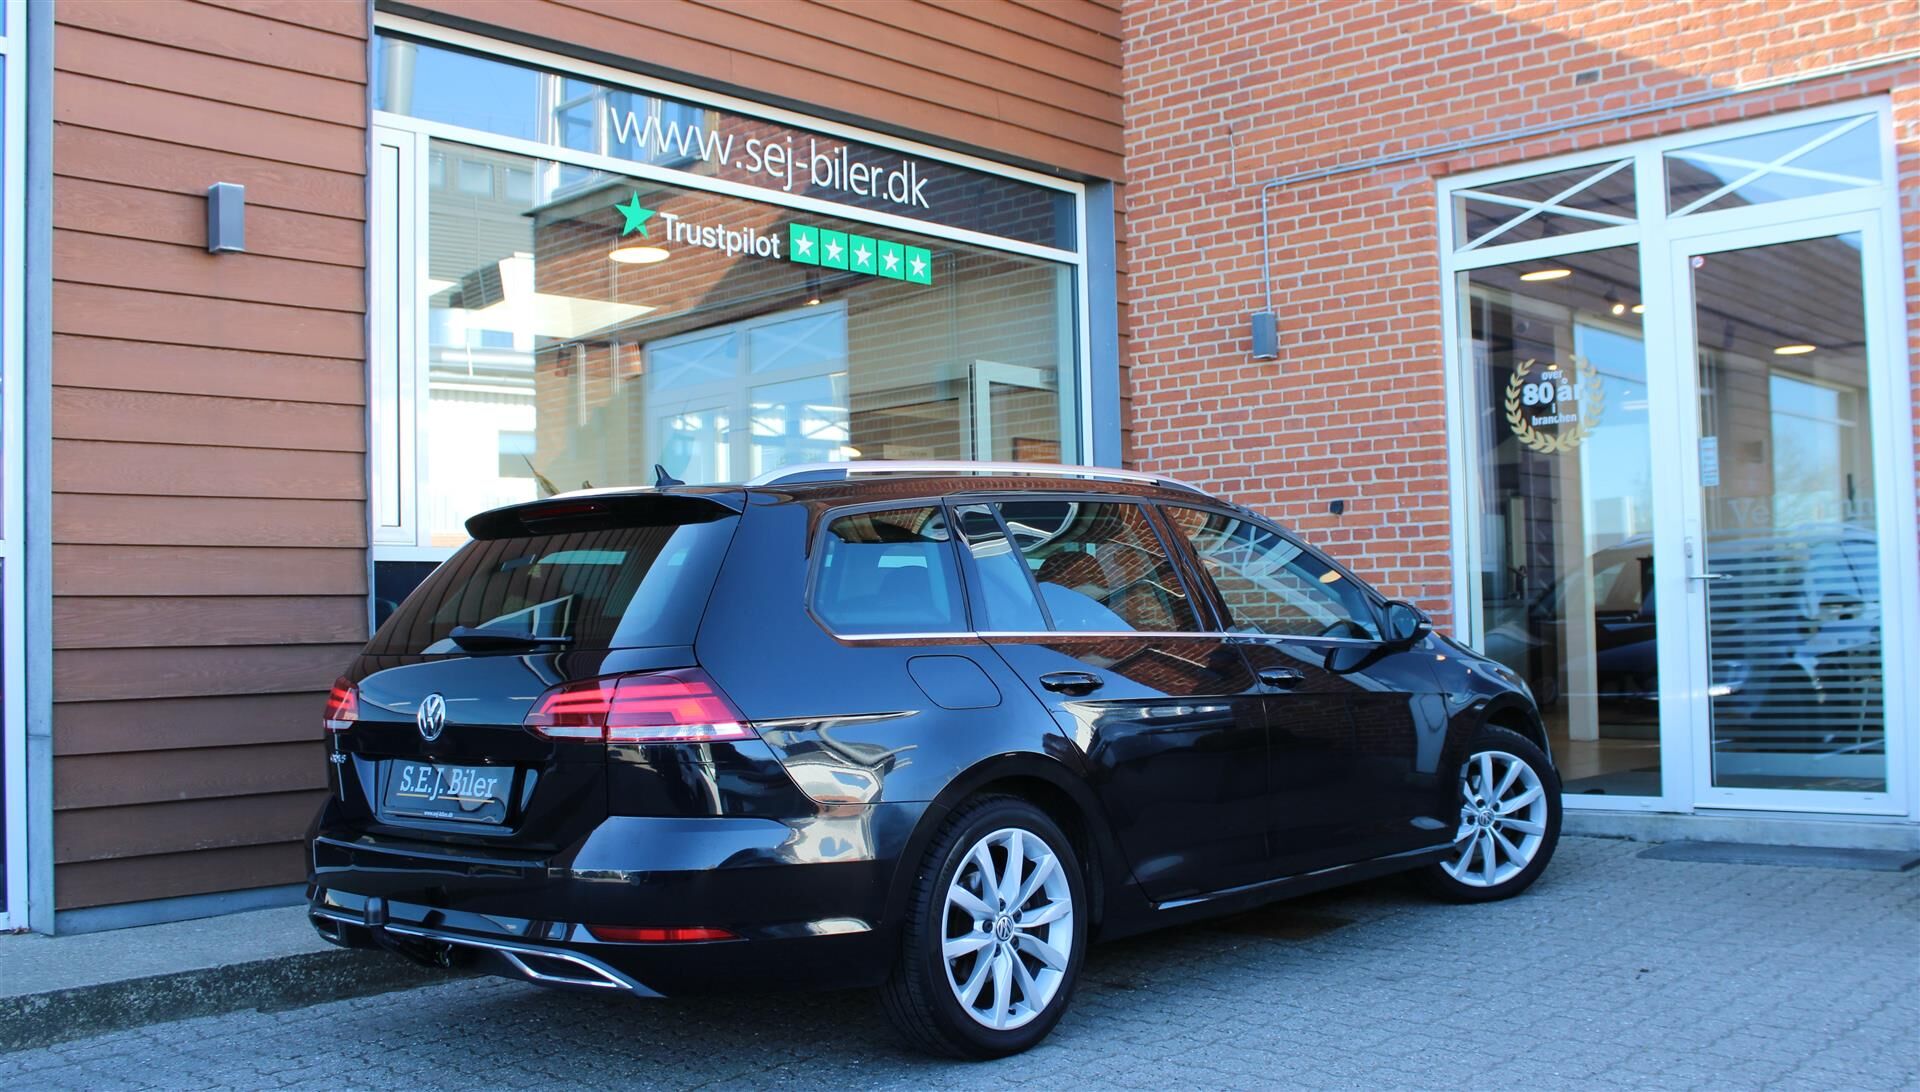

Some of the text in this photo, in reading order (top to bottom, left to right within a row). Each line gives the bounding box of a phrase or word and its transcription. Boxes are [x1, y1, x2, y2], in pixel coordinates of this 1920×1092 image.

[610, 106, 930, 209] www.sej-biler.dk
[660, 212, 781, 260] Trustpilot
[1541, 370, 1563, 381] over
[1523, 378, 1582, 405] 80 år
[1531, 414, 1577, 426] branchen
[400, 765, 498, 801] S.E.J. Biler
